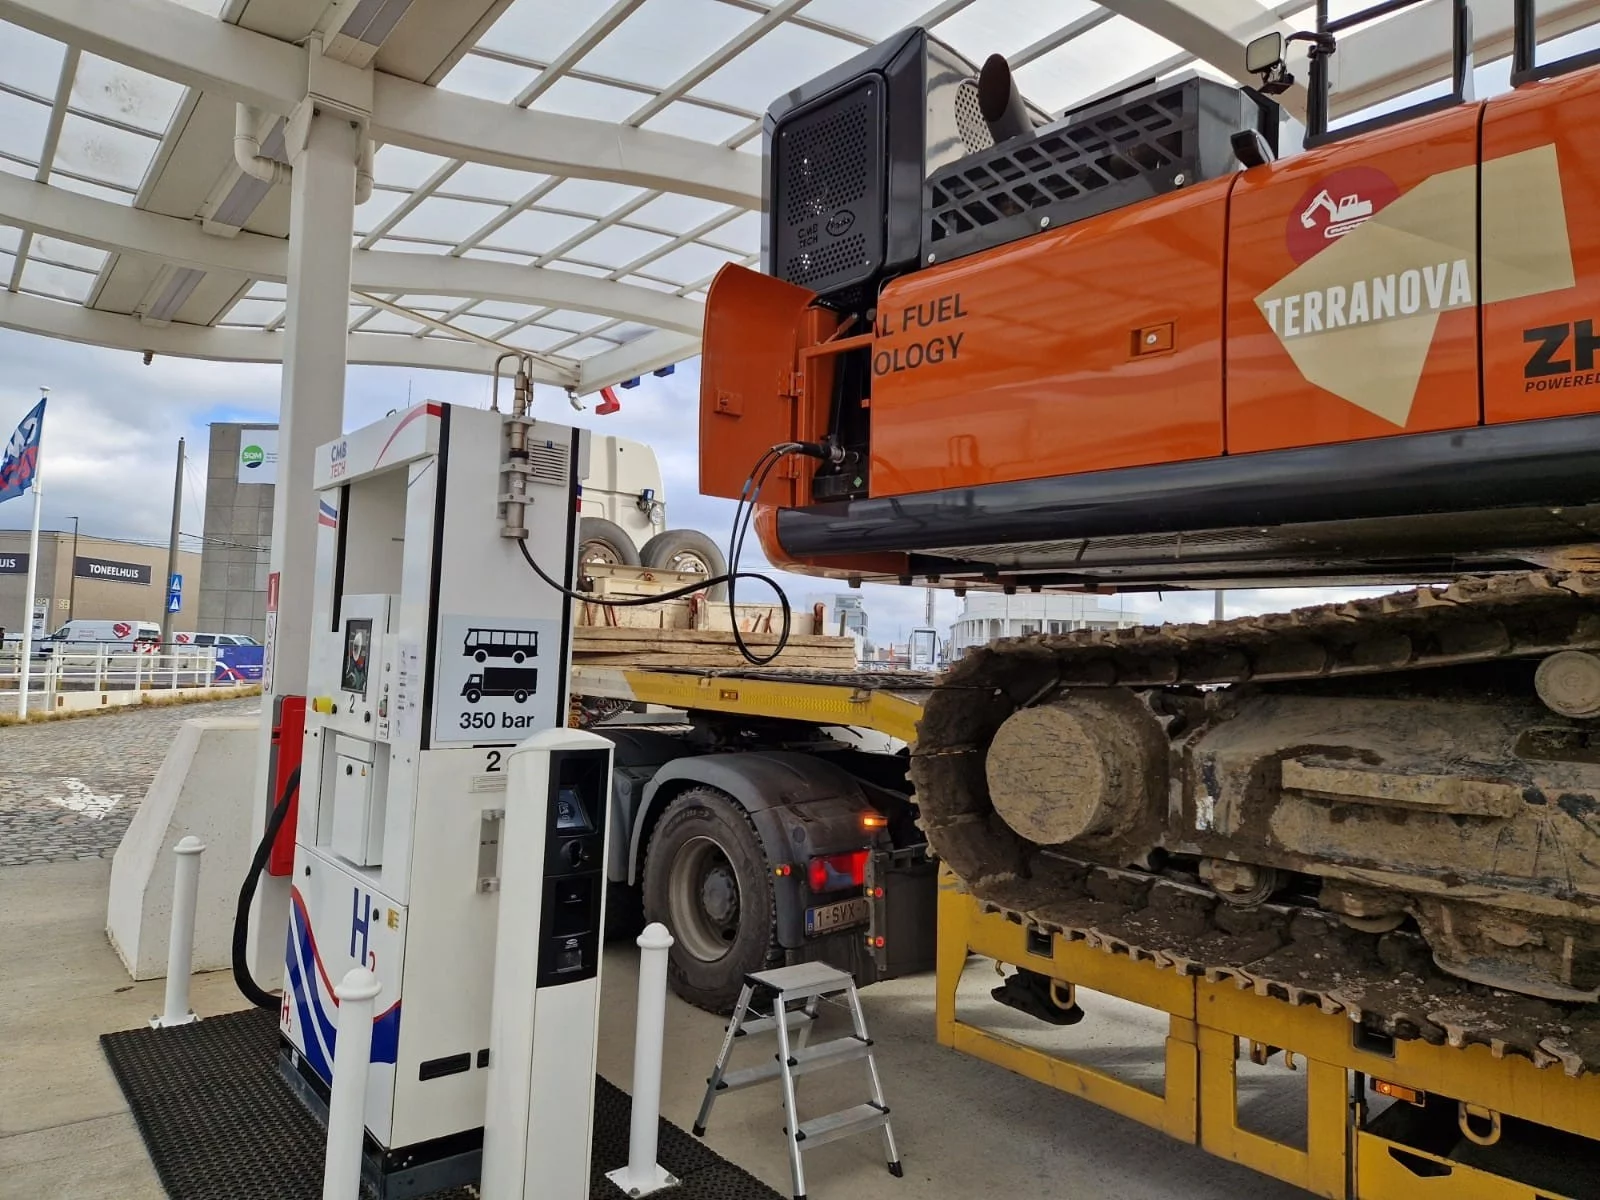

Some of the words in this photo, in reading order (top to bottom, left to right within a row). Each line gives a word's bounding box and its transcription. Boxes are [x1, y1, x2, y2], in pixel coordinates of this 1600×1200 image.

[1263, 259, 1472, 337] TERRANOVA
[903, 293, 968, 332] FUEL
[873, 332, 964, 376] OLOGY
[331, 441, 347, 462] CMB
[89, 564, 140, 578] TONEELHUIS
[348, 693, 356, 714] 2
[459, 712, 496, 729] 350
[502, 712, 535, 729] bar
[486, 750, 501, 772] 2
